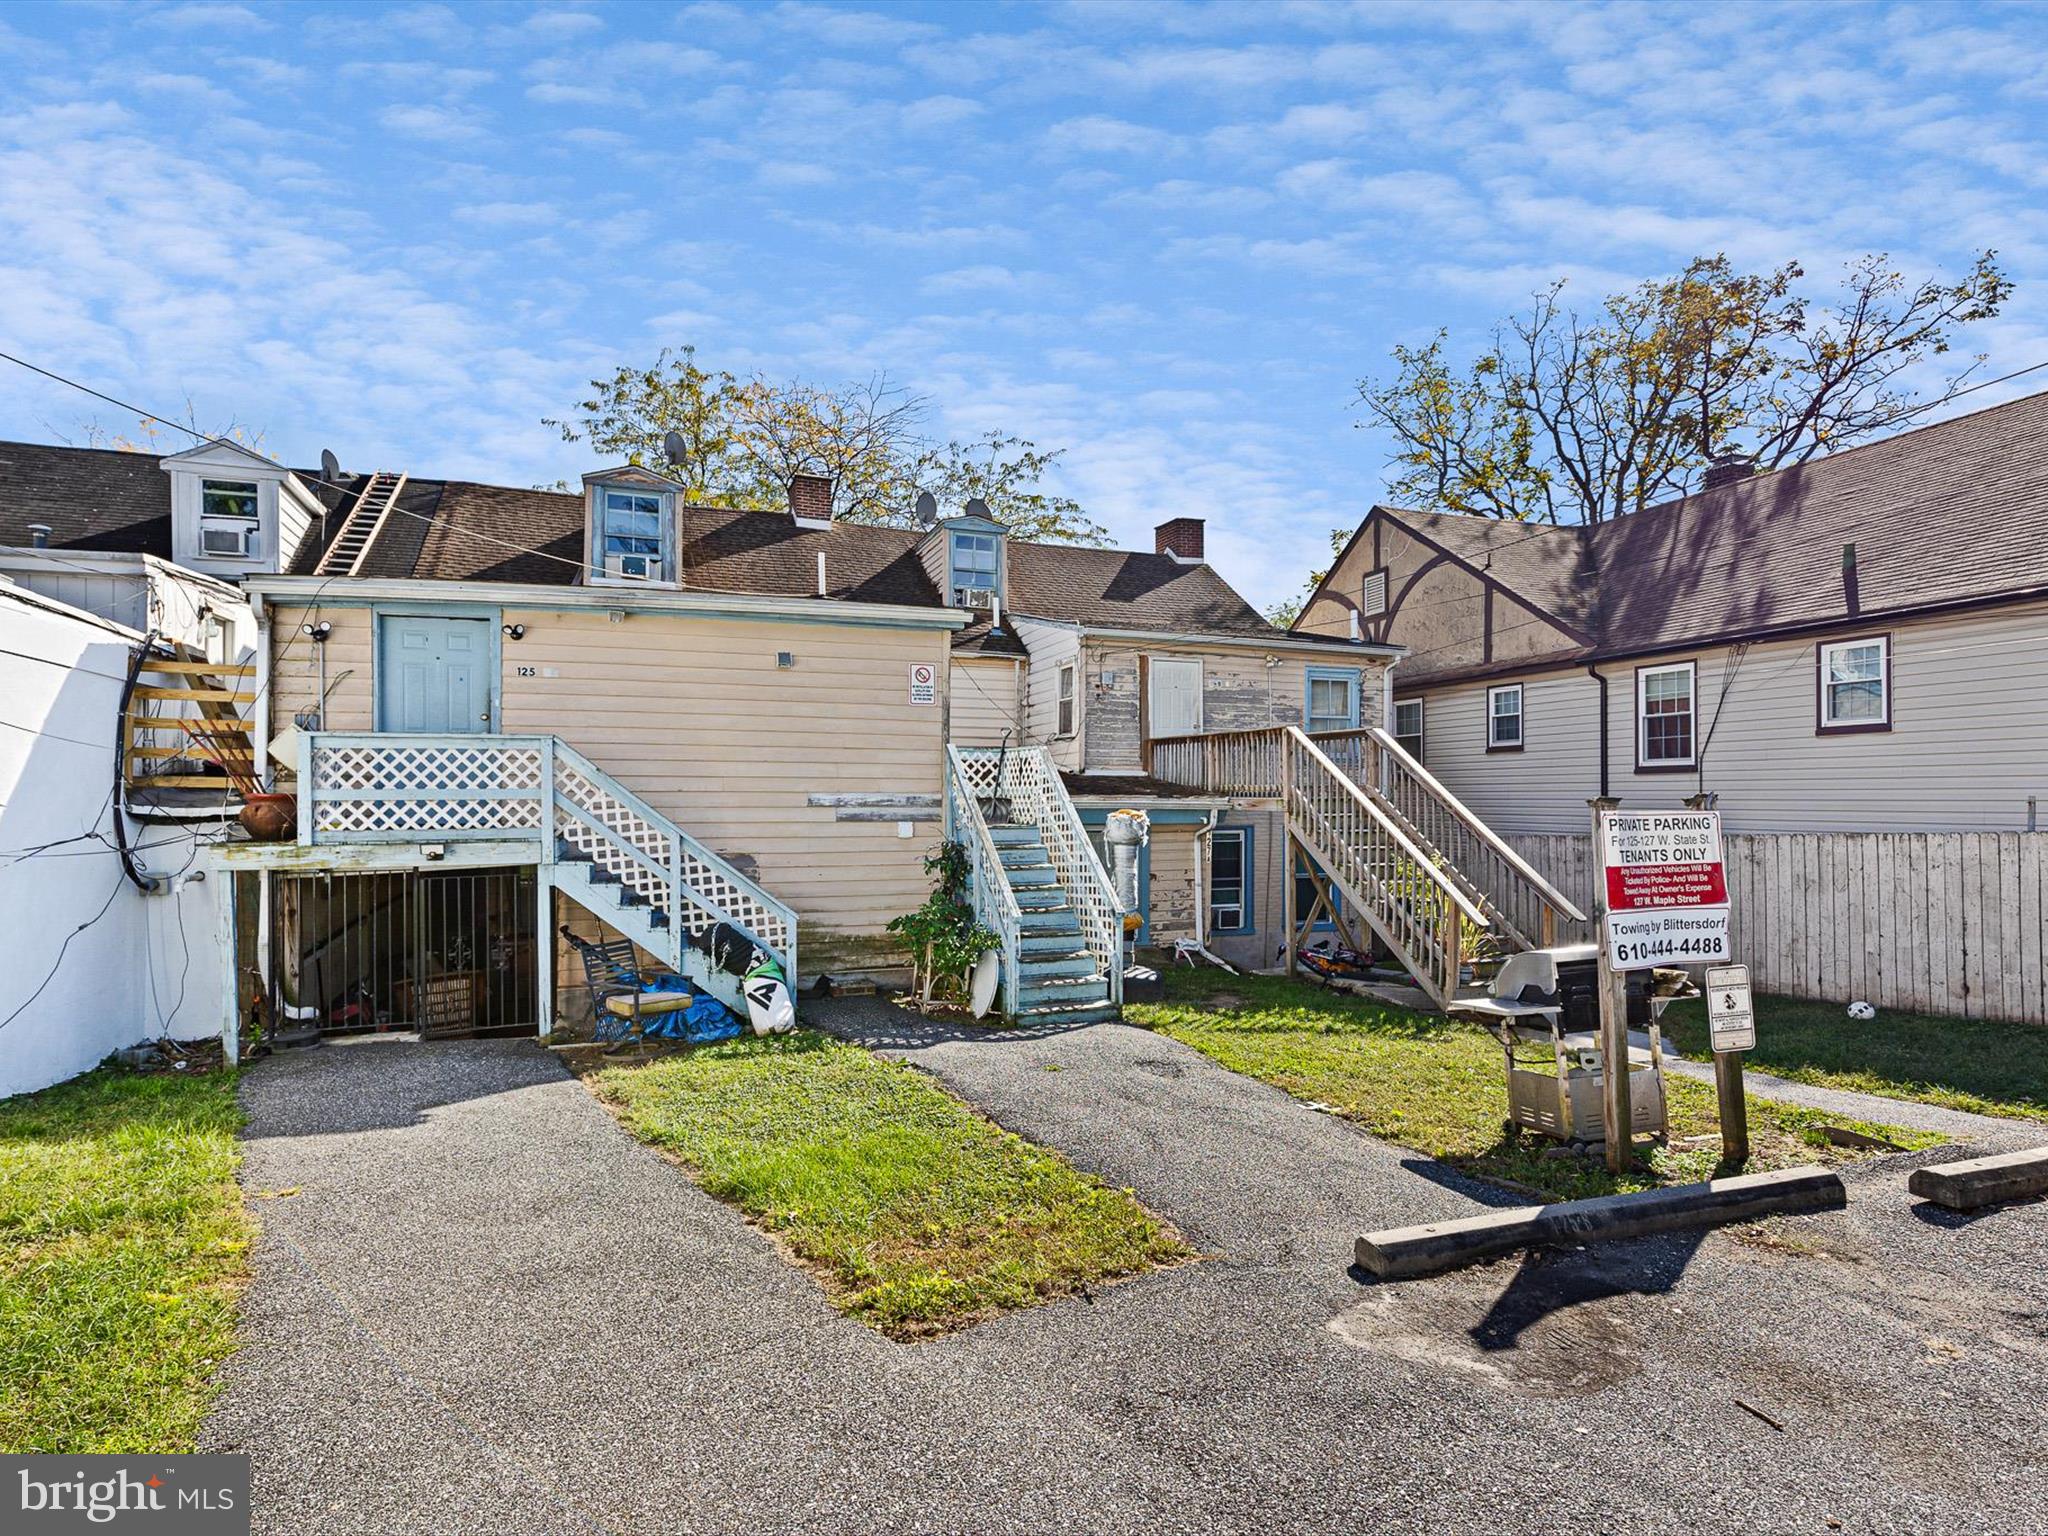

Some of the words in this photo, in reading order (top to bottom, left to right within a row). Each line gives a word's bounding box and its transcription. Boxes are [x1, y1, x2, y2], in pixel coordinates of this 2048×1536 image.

[517, 666, 536, 677] 125
[1609, 818, 1650, 832] PRIVATE
[1654, 817, 1711, 831] PARKING
[1611, 835, 1625, 847] For
[1626, 835, 1655, 847] 125-127
[1657, 834, 1671, 846] W.
[1674, 833, 1698, 845] State
[1619, 848, 1669, 863] TENANTS
[1673, 847, 1707, 861] ONLY
[1663, 865, 1690, 874] Vehicles
[1690, 864, 1702, 872] Will
[1703, 864, 1712, 872] Be
[1673, 875, 1686, 883] And
[1686, 874, 1700, 882] Will
[1700, 874, 1708, 882] Be
[1651, 886, 1659, 894] At
[1659, 885, 1685, 894] Owner's
[1686, 884, 1713, 893] Expense
[1634, 897, 1644, 906] 127
[1653, 896, 1676, 906] Maple
[1677, 894, 1701, 904] Street
[1611, 922, 1651, 936] Towing
[1651, 920, 1662, 934] by
[1663, 916, 1726, 931] Blittersdorf
[1617, 937, 1723, 961] 610-444-4488
